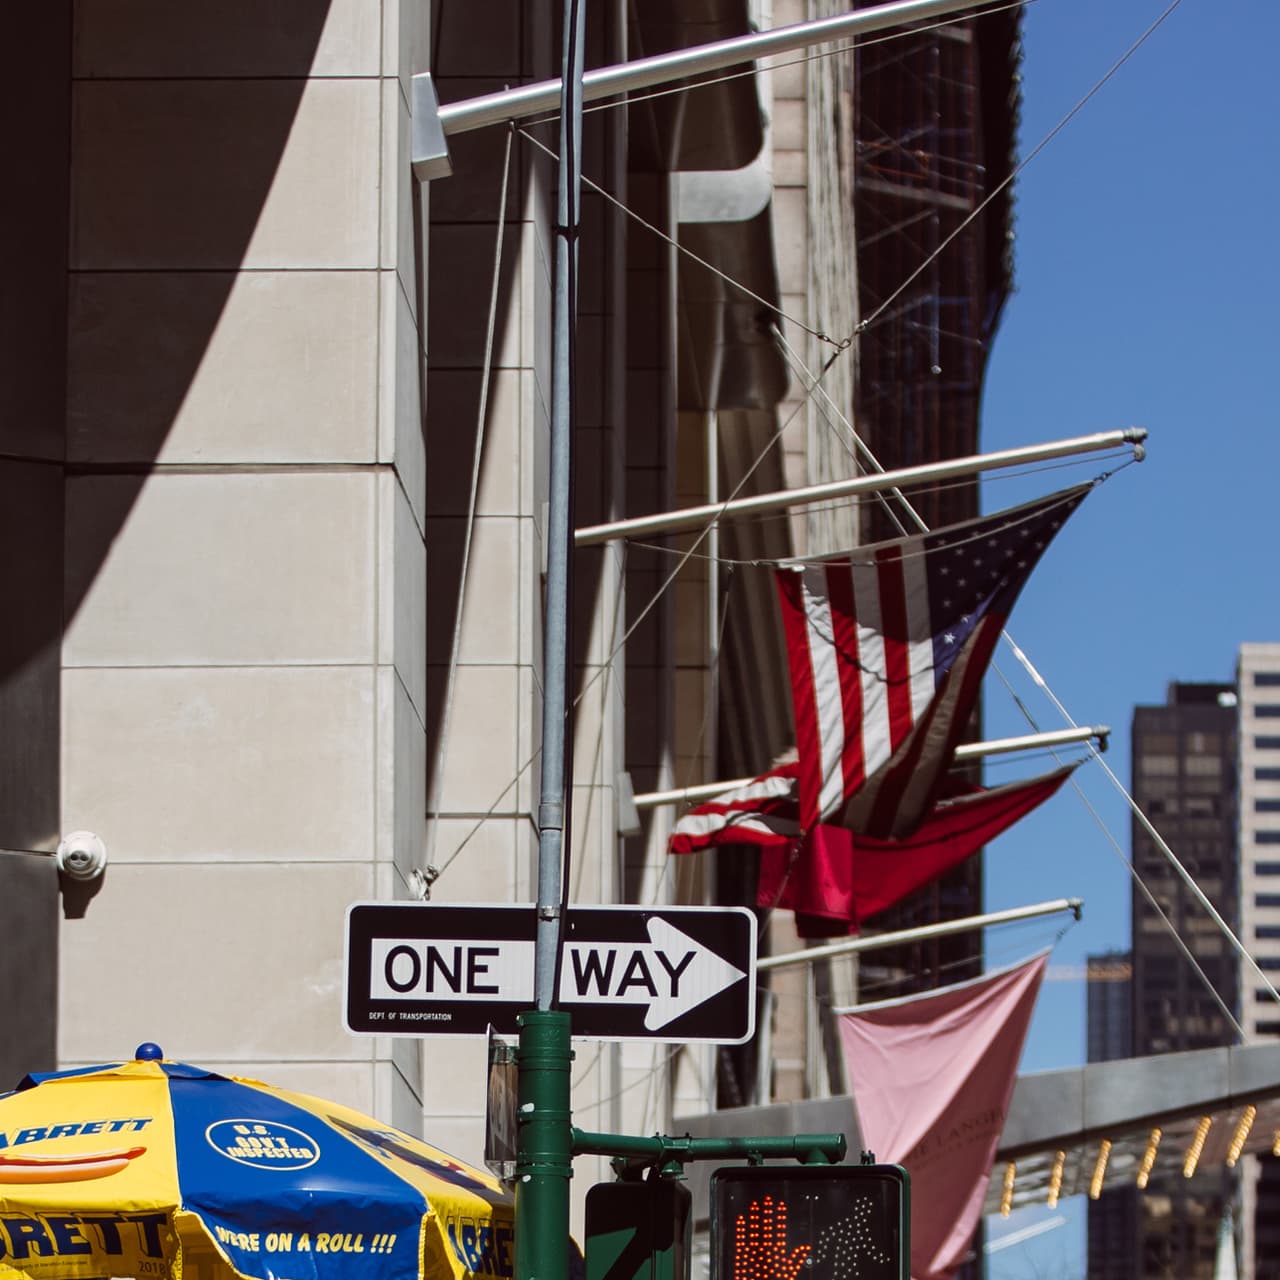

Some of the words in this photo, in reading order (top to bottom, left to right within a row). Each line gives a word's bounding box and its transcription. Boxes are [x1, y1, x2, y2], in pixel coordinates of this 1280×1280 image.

[384, 945, 500, 995] ONE
[571, 949, 697, 998] WAY
[369, 1012, 385, 1021] DEPT
[388, 1012, 396, 1021] OF
[399, 1012, 452, 1022] TRANSPORTATION
[233, 1124, 271, 1136] U.S.
[236, 1136, 289, 1149] GOV'T
[227, 1147, 314, 1159] INSPECTED
[265, 1233, 293, 1252] ON
[297, 1233, 311, 1252] A
[315, 1233, 364, 1254] ROLL
[370, 1234, 397, 1254] !!!
[139, 1260, 167, 1274] 2018
